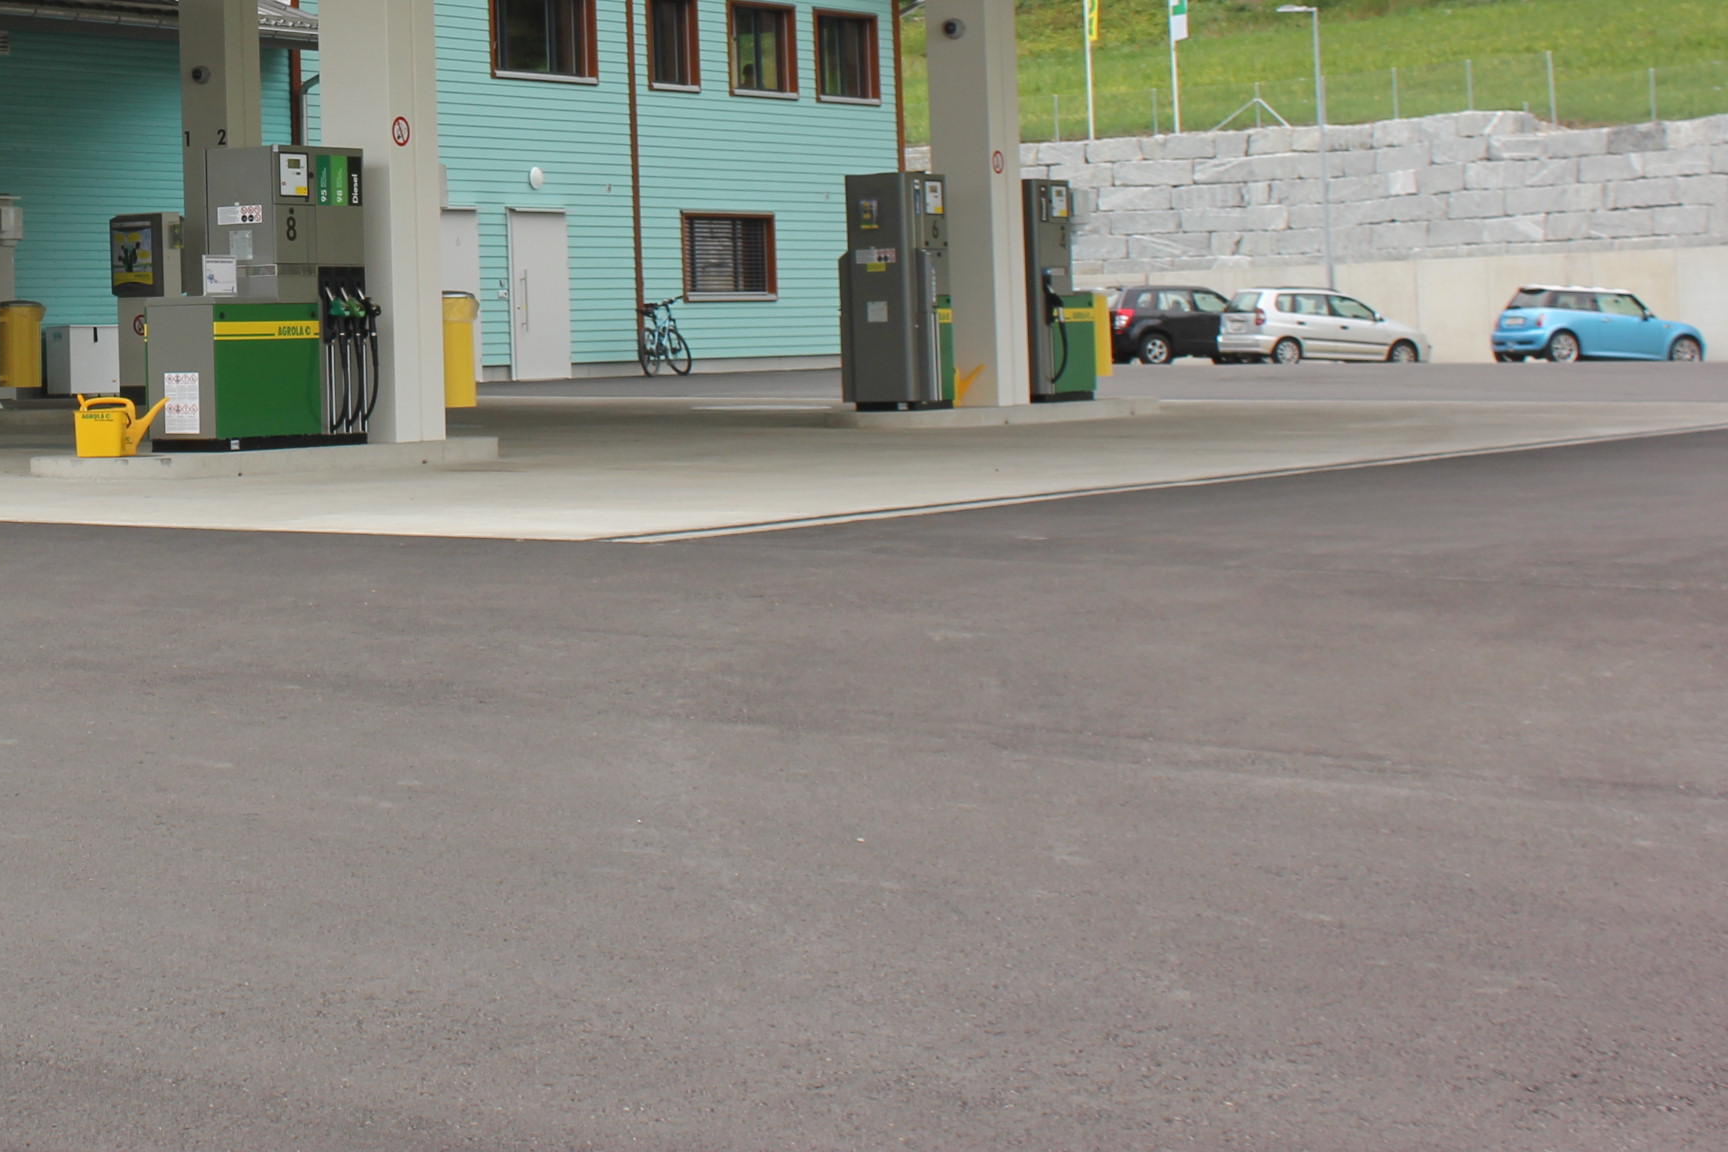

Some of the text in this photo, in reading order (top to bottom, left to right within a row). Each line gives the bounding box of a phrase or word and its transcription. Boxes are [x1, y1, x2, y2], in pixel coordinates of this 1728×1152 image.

[184, 130, 190, 147] 1
[217, 128, 227, 146] 2
[321, 189, 328, 203] 95
[336, 189, 343, 203] 98
[351, 173, 359, 204] Diesel
[286, 216, 297, 242] 8
[277, 326, 304, 337] AGROLA
